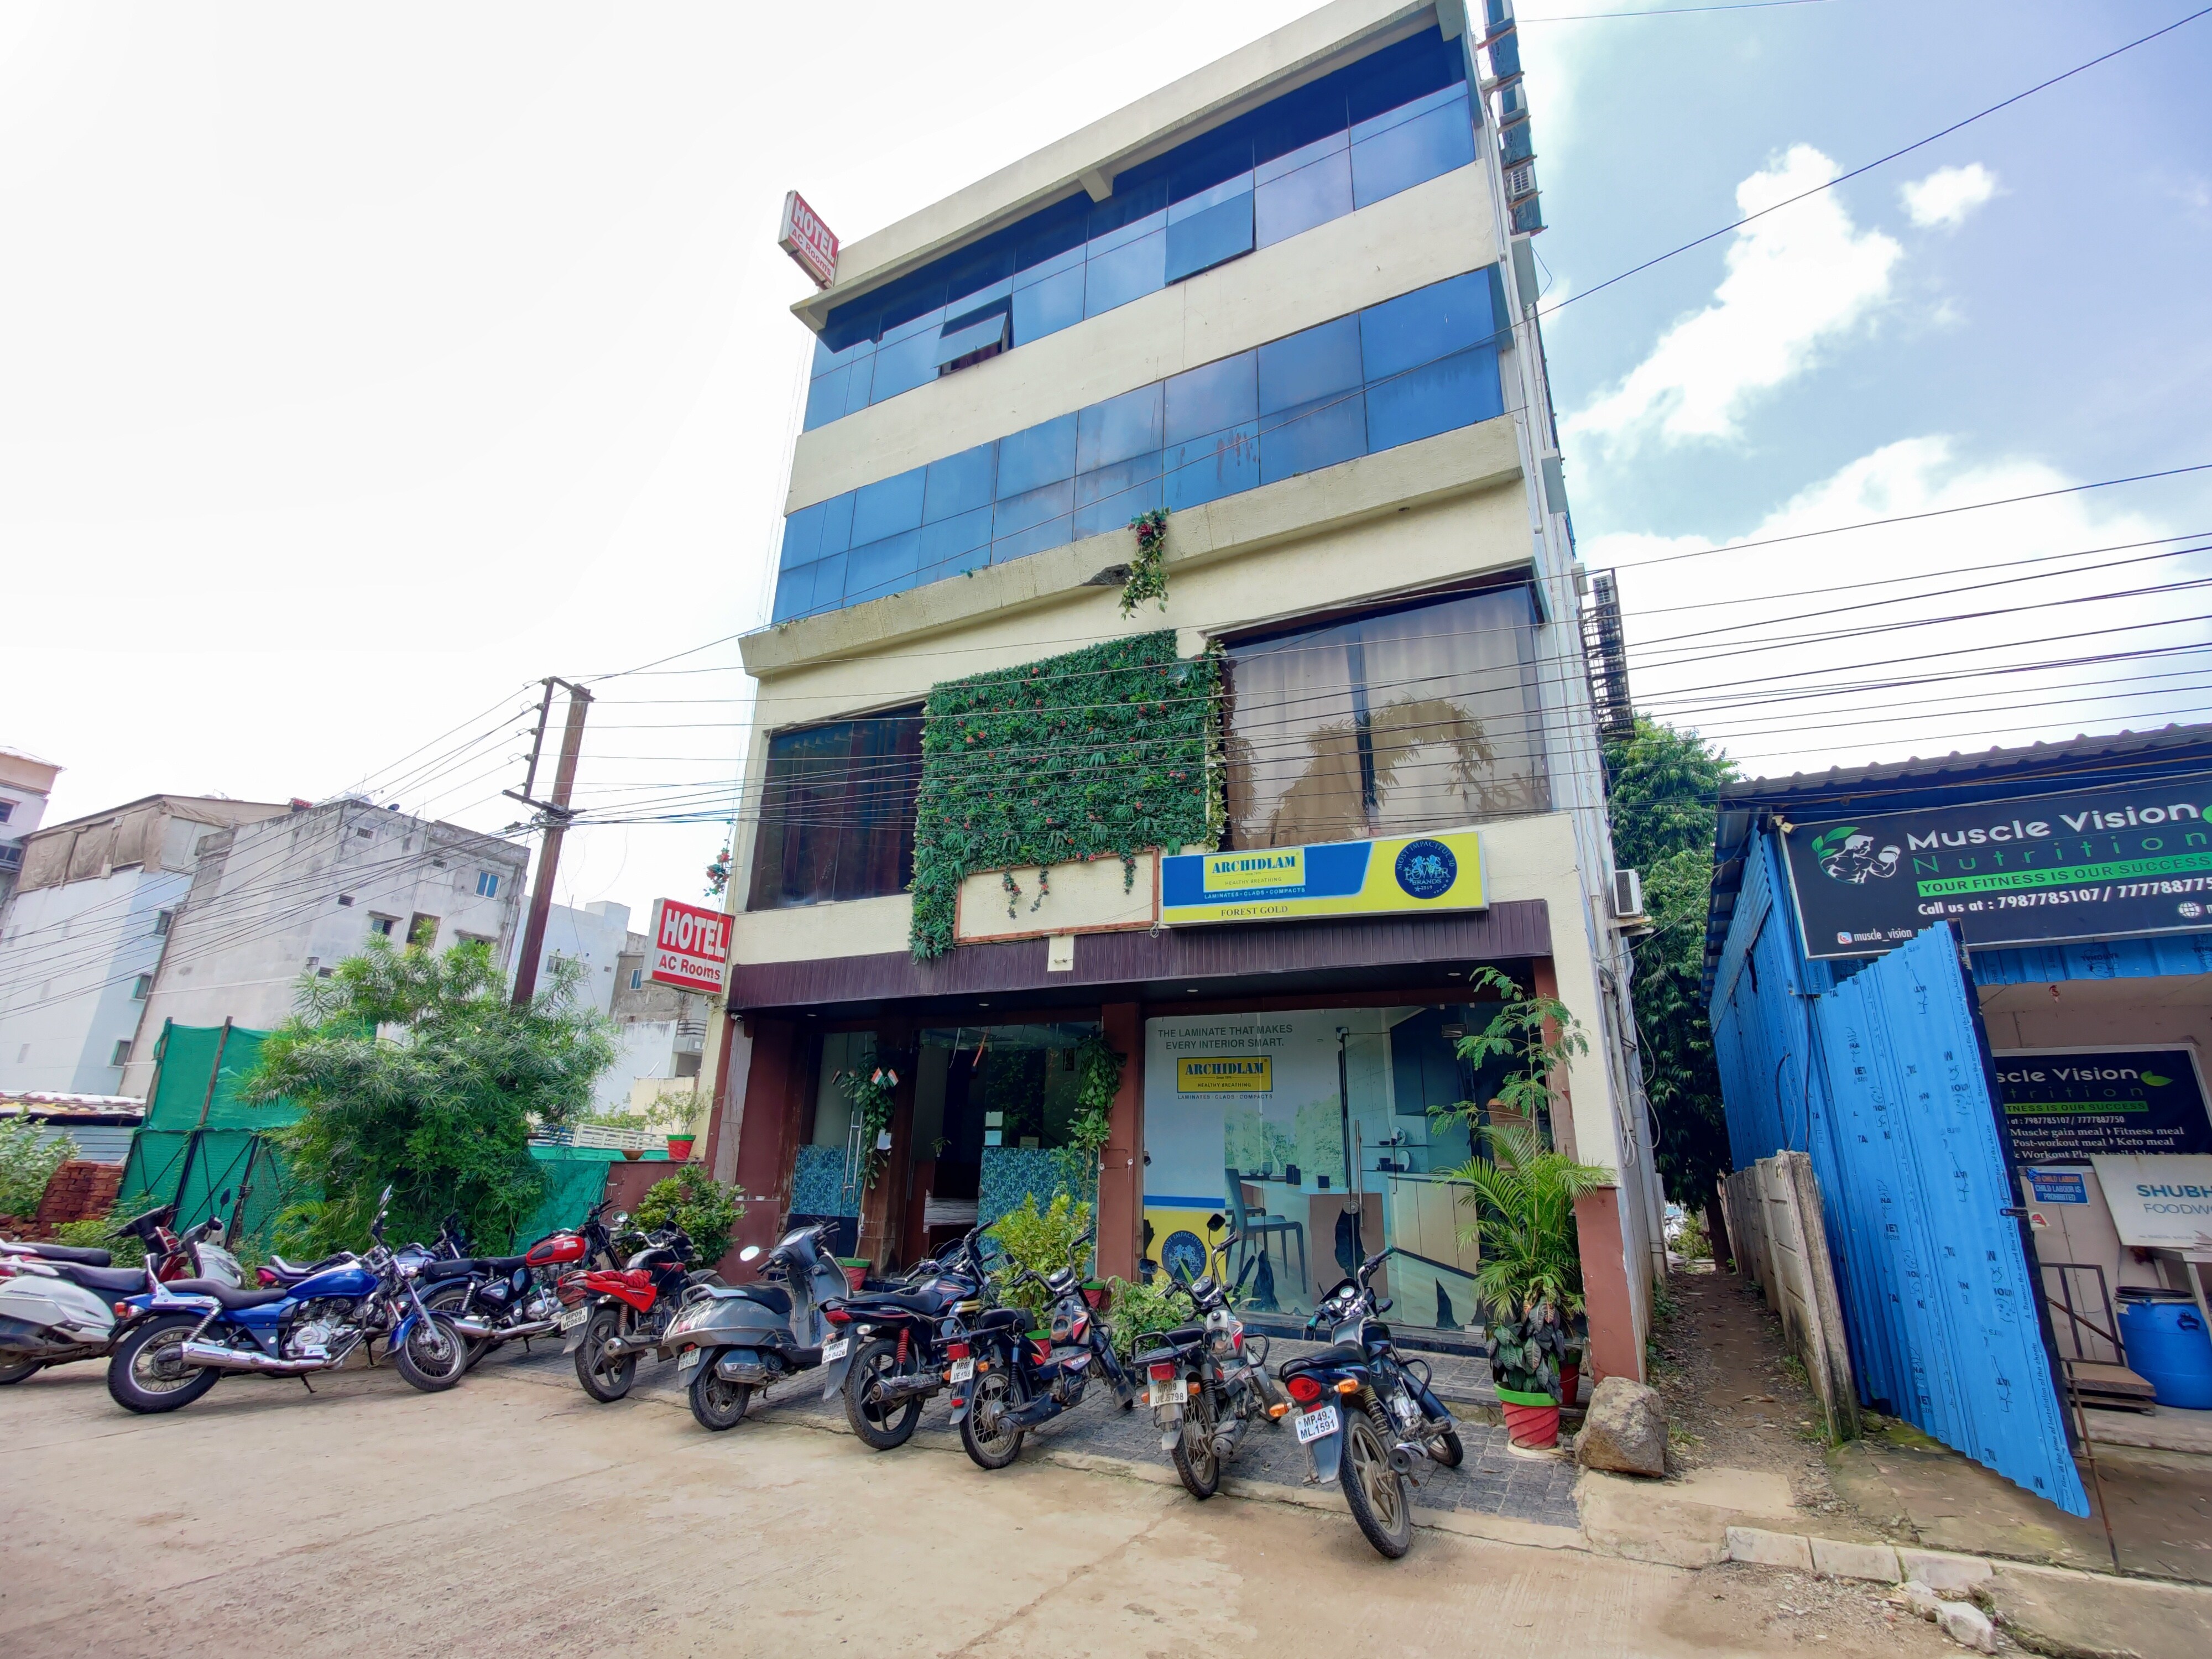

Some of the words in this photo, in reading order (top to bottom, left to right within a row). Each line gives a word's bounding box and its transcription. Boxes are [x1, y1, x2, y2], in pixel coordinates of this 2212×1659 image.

[794, 200, 834, 263] HOTEL
[792, 229, 803, 244] AC
[805, 242, 832, 276] Rooms
[1907, 820, 2051, 851] Muscle
[2058, 803, 2199, 832] Vision
[1396, 849, 1409, 870] MOST
[1409, 841, 1450, 858] IMPACTFUL
[1447, 858, 1455, 867] 30
[1912, 832, 2207, 875] Nutrition
[1212, 855, 1296, 874] ARCHIDLAM
[1405, 865, 1451, 880] POWER
[1922, 880, 1968, 893] YOUR
[1973, 873, 2046, 888] FITNESS
[2051, 870, 2069, 880] IS
[2074, 867, 2114, 878] OUR
[2119, 857, 2211, 874] SUCCESS
[1221, 907, 1258, 917] FOREST
[1260, 905, 1288, 915] GOLD
[1918, 901, 1944, 915] Call
[1948, 904, 1965, 913] us
[1968, 900, 1983, 911] at
[662, 908, 726, 958] HOTEL
[659, 954, 677, 971] AC
[680, 958, 721, 980] Rooms
[1158, 1029, 1176, 1038] THE
[1179, 1027, 1226, 1037] LAMINATE
[1229, 1026, 1254, 1035] THAT
[1257, 1024, 1293, 1034] MAKES
[1166, 1041, 1196, 1050] EVERY
[1199, 1039, 1244, 1048] INTERIOR
[1248, 1037, 1284, 1047] SMART.
[1185, 1062, 1264, 1075] ARCHIDLAM
[1996, 1070, 2046, 1083] scle
[2052, 1067, 2138, 1082] Vision
[2010, 1128, 2048, 1136] Muscle
[2052, 1128, 2075, 1138] gain
[2077, 1128, 2104, 1136] meal
[2113, 1126, 2154, 1135] Fitness
[2156, 1126, 2184, 1135] meal
[2013, 1139, 2079, 1147] Post-workout
[2081, 1138, 2107, 1146] meal
[2116, 1138, 2143, 1146] Keto
[2146, 1137, 2175, 1145] meal
[2022, 1150, 2070, 1159] Workout
[2143, 1203, 2212, 1214] FOODW
[1163, 1238, 1173, 1255] MOST
[1173, 1232, 1203, 1249] IMPACTFUL
[565, 1310, 582, 1321] MP09
[1300, 1418, 1335, 1439] ML.1591
